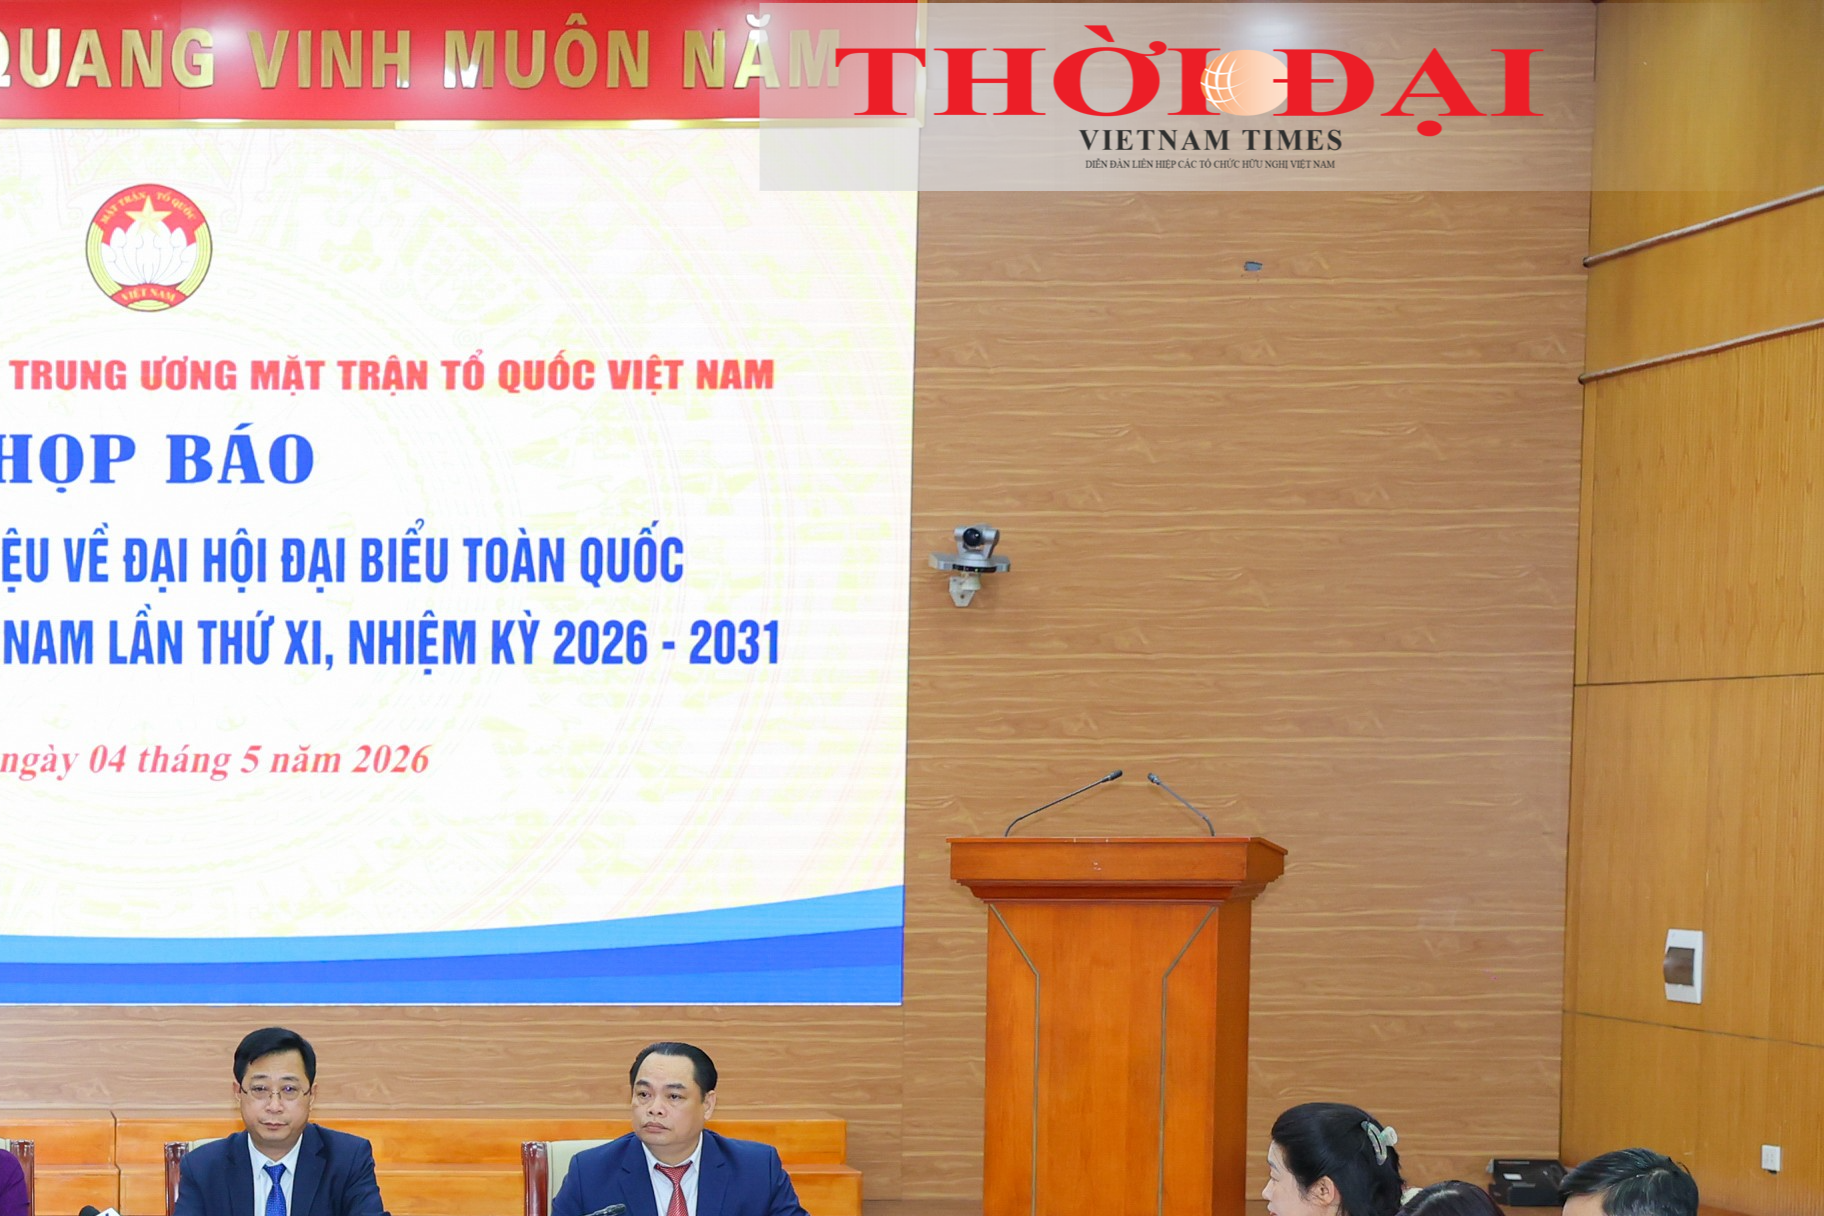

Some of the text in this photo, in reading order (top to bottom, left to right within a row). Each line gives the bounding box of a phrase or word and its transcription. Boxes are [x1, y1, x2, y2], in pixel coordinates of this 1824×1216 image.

[247, 28, 412, 89] VINH
[444, 12, 650, 89] MUÔN
[682, 13, 841, 90] NĂM
[150, 288, 177, 302] NAM
[9, 359, 127, 391] TRUNG
[140, 356, 237, 391] ƯƠNG
[250, 355, 326, 397] MẶT
[336, 354, 428, 397] TRẬN
[440, 349, 485, 391] TỔ
[498, 349, 596, 394] QUỐC
[607, 353, 685, 396] VIỆT
[696, 359, 775, 390] NAM
[166, 422, 314, 485] BÁO
[64, 522, 110, 583] VỀ
[123, 537, 188, 594] ĐẠI
[203, 527, 267, 594] HỘI
[281, 537, 346, 594] ĐẠI
[361, 518, 449, 584] BIỂU
[463, 527, 565, 584] TOÀN
[580, 520, 684, 589] QUỐC
[4, 619, 94, 665] NAM
[109, 603, 183, 665] LẦN
[197, 609, 275, 666] THỨ
[285, 619, 334, 671] XI,
[349, 609, 477, 676] NHIỆM
[491, 609, 541, 665] KỲ
[553, 619, 648, 665] 2026
[662, 640, 676, 650] -
[689, 619, 779, 665] 2031
[0, 743, 78, 781] ngày
[89, 744, 127, 774] 04
[137, 743, 232, 781] tháng
[241, 745, 262, 774] 5
[270, 746, 342, 773] năm
[352, 744, 430, 774] 2026
